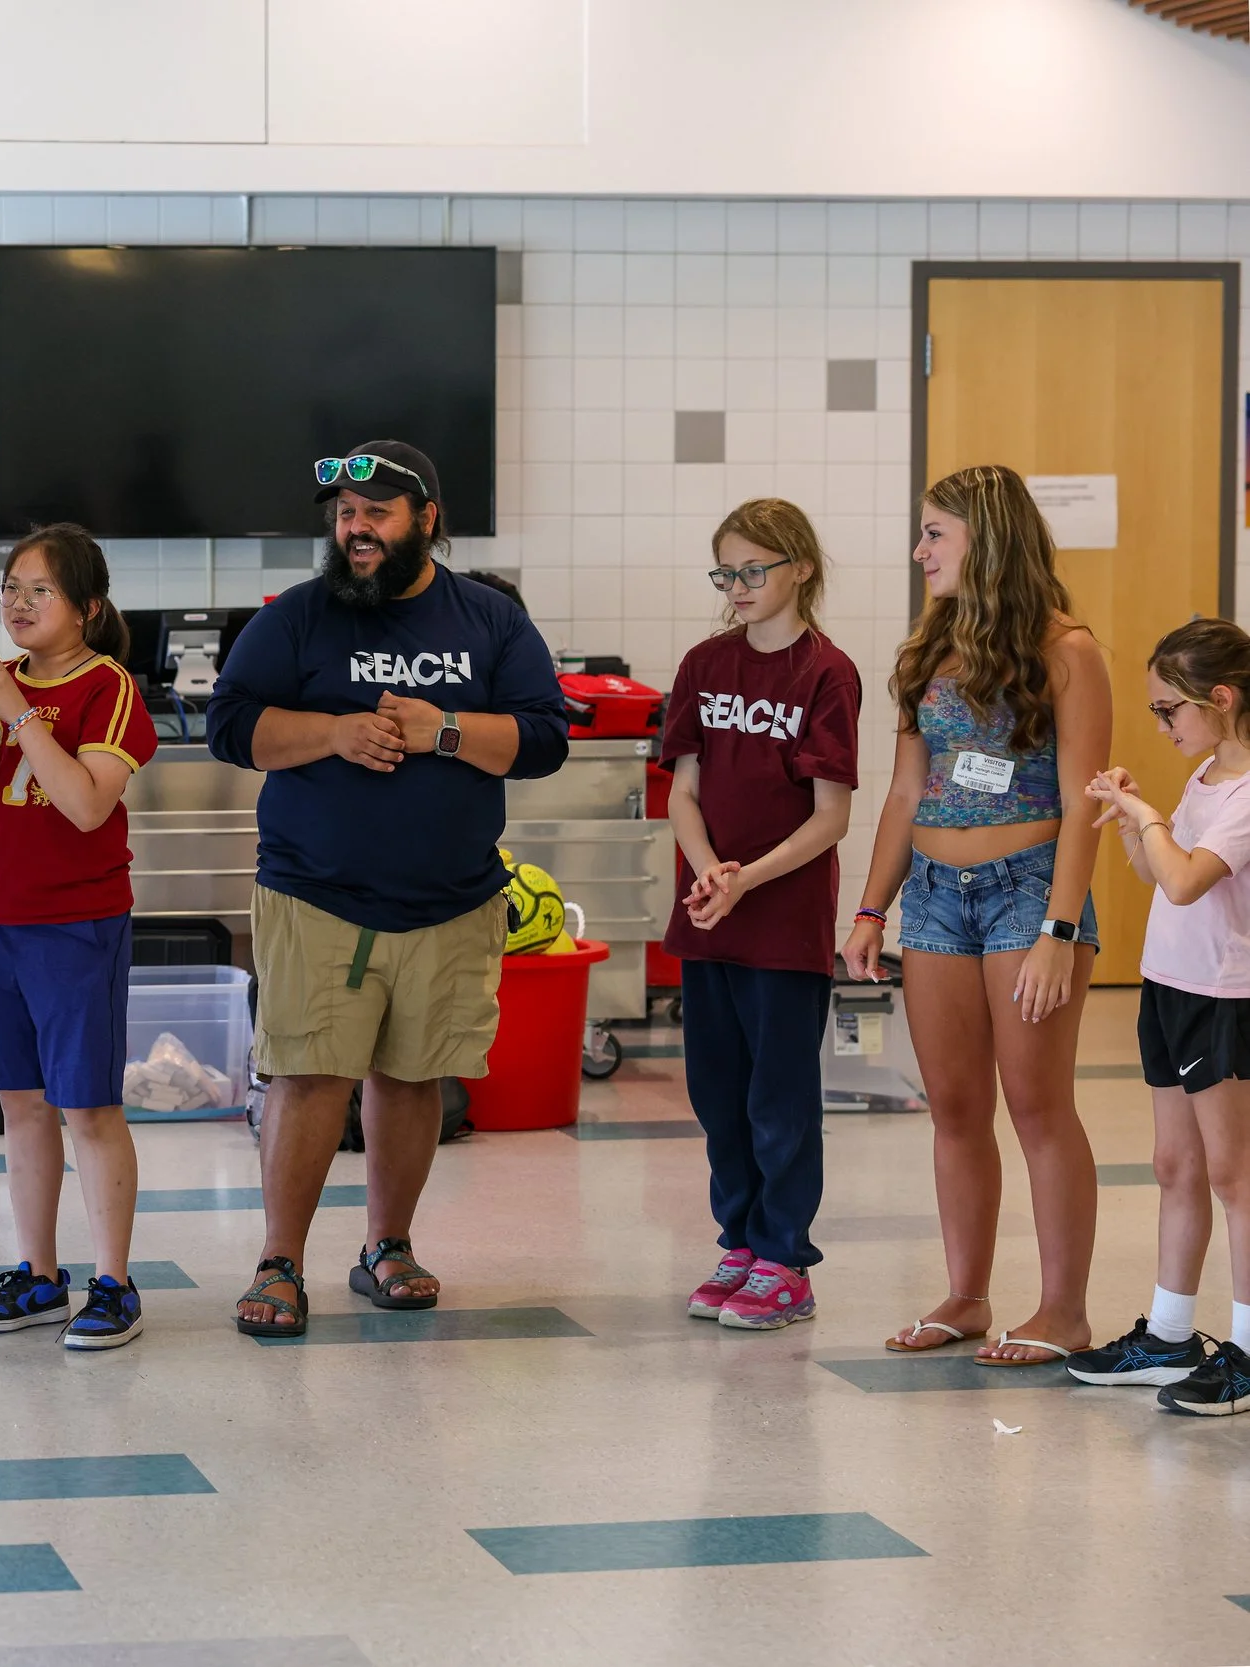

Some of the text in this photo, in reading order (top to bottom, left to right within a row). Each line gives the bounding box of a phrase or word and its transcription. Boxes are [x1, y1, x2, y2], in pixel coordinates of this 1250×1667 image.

[350, 651, 471, 687] REACH
[698, 692, 803, 740] REACH
[984, 757, 1007, 768] VISITOR
